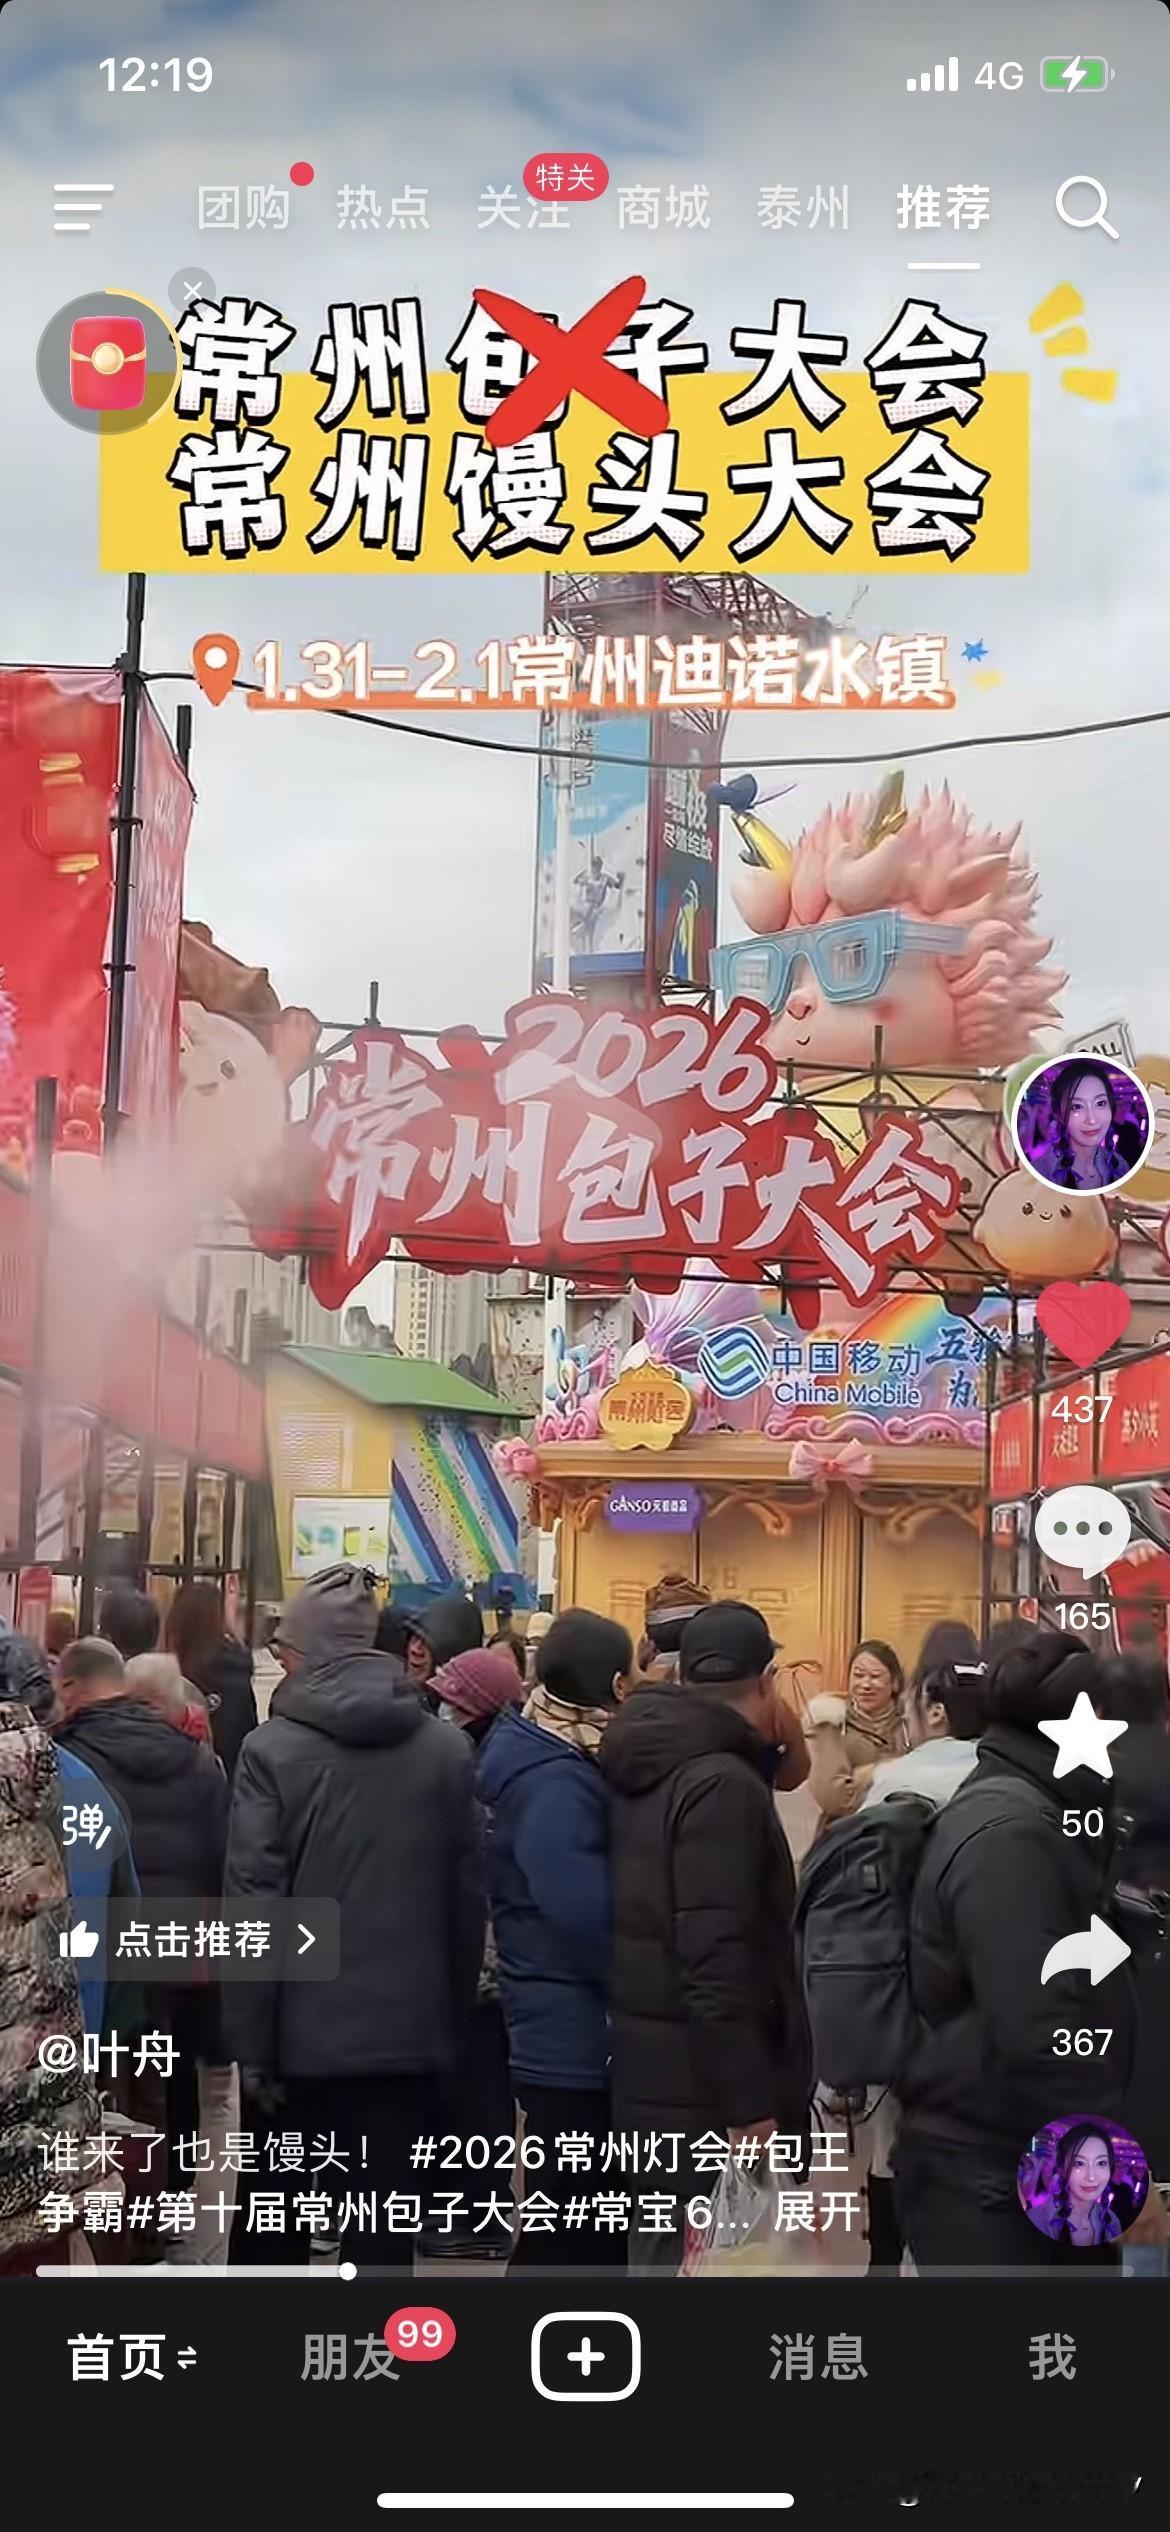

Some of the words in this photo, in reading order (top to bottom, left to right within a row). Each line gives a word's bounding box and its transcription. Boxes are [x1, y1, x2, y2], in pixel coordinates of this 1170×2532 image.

[494, 1000, 775, 1113] 2026
[310, 1040, 952, 1300] 常州包子大会
[772, 1340, 921, 1377] 中国移动
[774, 1382, 839, 1404] China
[846, 1382, 921, 1406] Mobile
